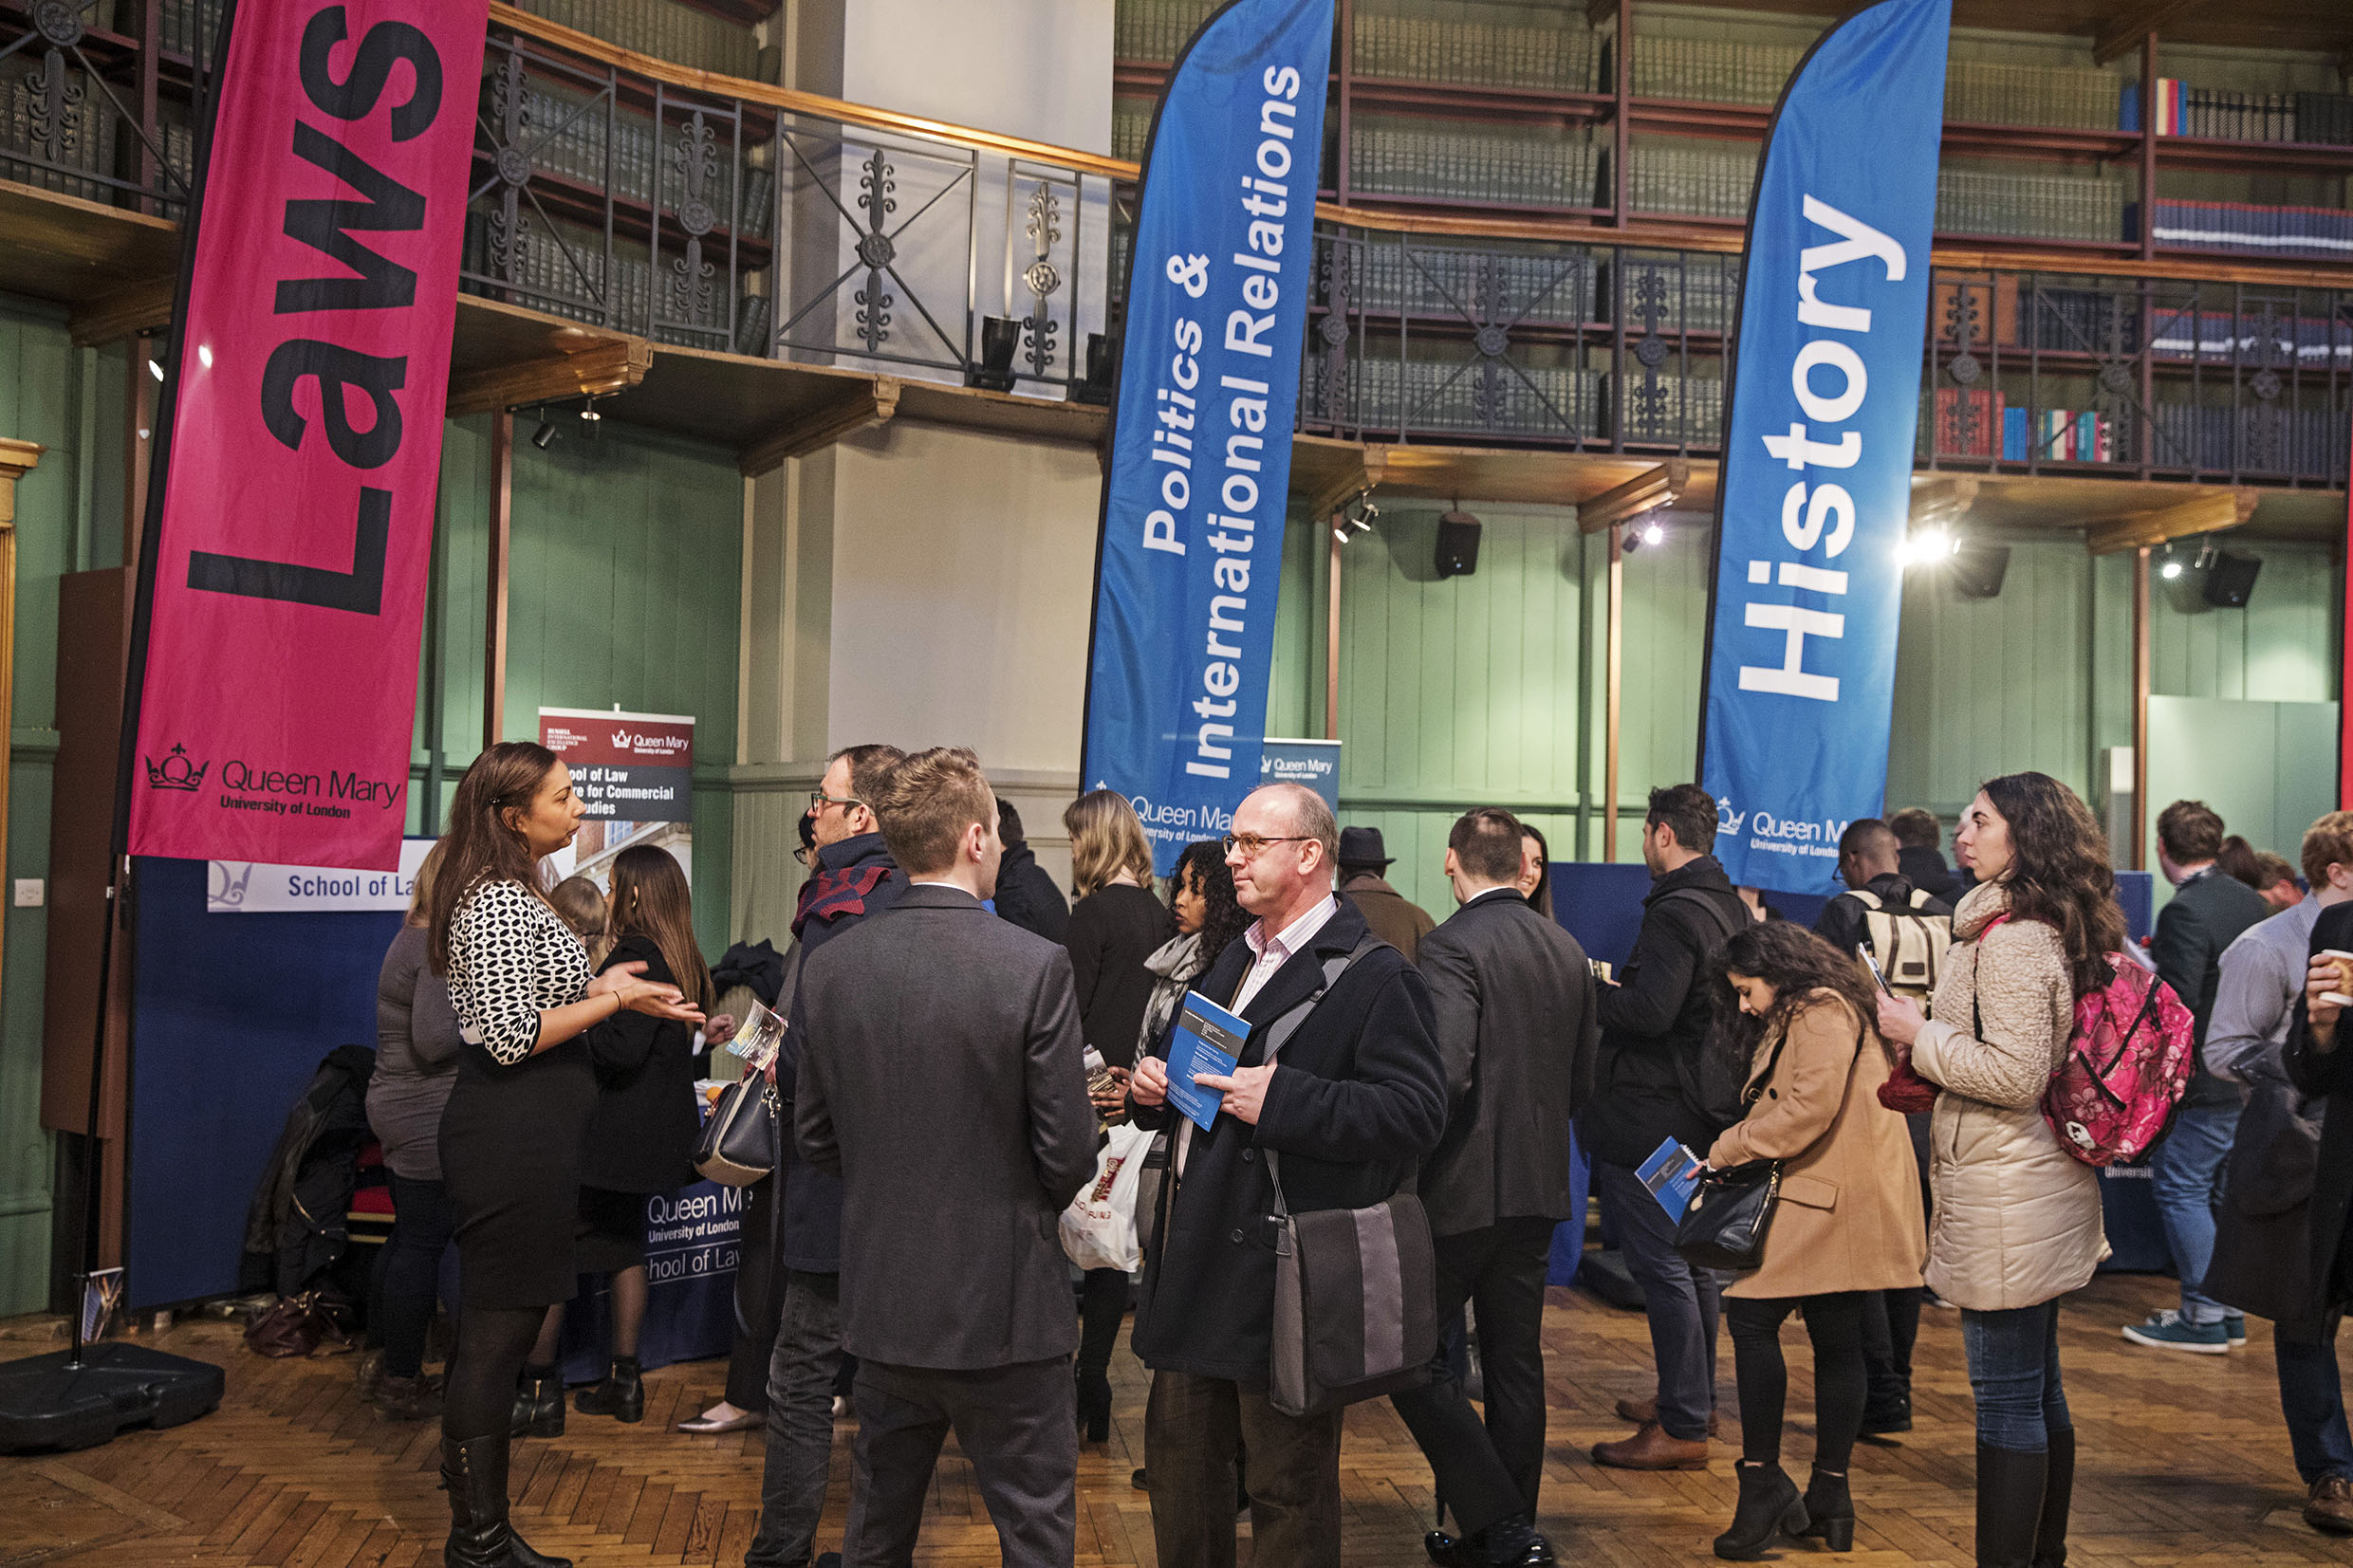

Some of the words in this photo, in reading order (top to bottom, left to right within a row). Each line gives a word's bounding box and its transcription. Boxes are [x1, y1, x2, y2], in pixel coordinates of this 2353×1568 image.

[1225, 65, 1301, 358] Relations
[1166, 252, 1210, 299] &
[186, 5, 443, 617] Laws
[1142, 317, 1203, 556] Politics
[1738, 194, 1907, 702] History
[1185, 376, 1269, 779] International
[634, 734, 665, 747] Queen
[666, 736, 690, 751] Mary
[590, 768, 602, 782] of
[605, 768, 628, 783] Law
[1274, 758, 1306, 772] Queen
[1307, 759, 1332, 775] Mary
[222, 760, 321, 796] Queen
[329, 769, 400, 809] Mary
[587, 784, 604, 798] for
[606, 785, 674, 801] Commercial
[220, 795, 287, 816] University
[290, 802, 303, 814] of
[306, 805, 351, 819] London
[585, 801, 616, 815] udies
[1131, 796, 1196, 827] Queen
[1176, 830, 1184, 840] of
[1752, 811, 1821, 841] Queen
[1751, 838, 1798, 856] University
[1798, 844, 1808, 855] of
[1809, 845, 1840, 858] Londo
[288, 875, 360, 897] School
[368, 875, 387, 896] of
[395, 876, 416, 896] La
[648, 1194, 716, 1224] Queen
[649, 1225, 695, 1244] University
[695, 1223, 706, 1236] of
[708, 1220, 740, 1235] London
[646, 1253, 686, 1280] hool
[692, 1249, 711, 1273] of
